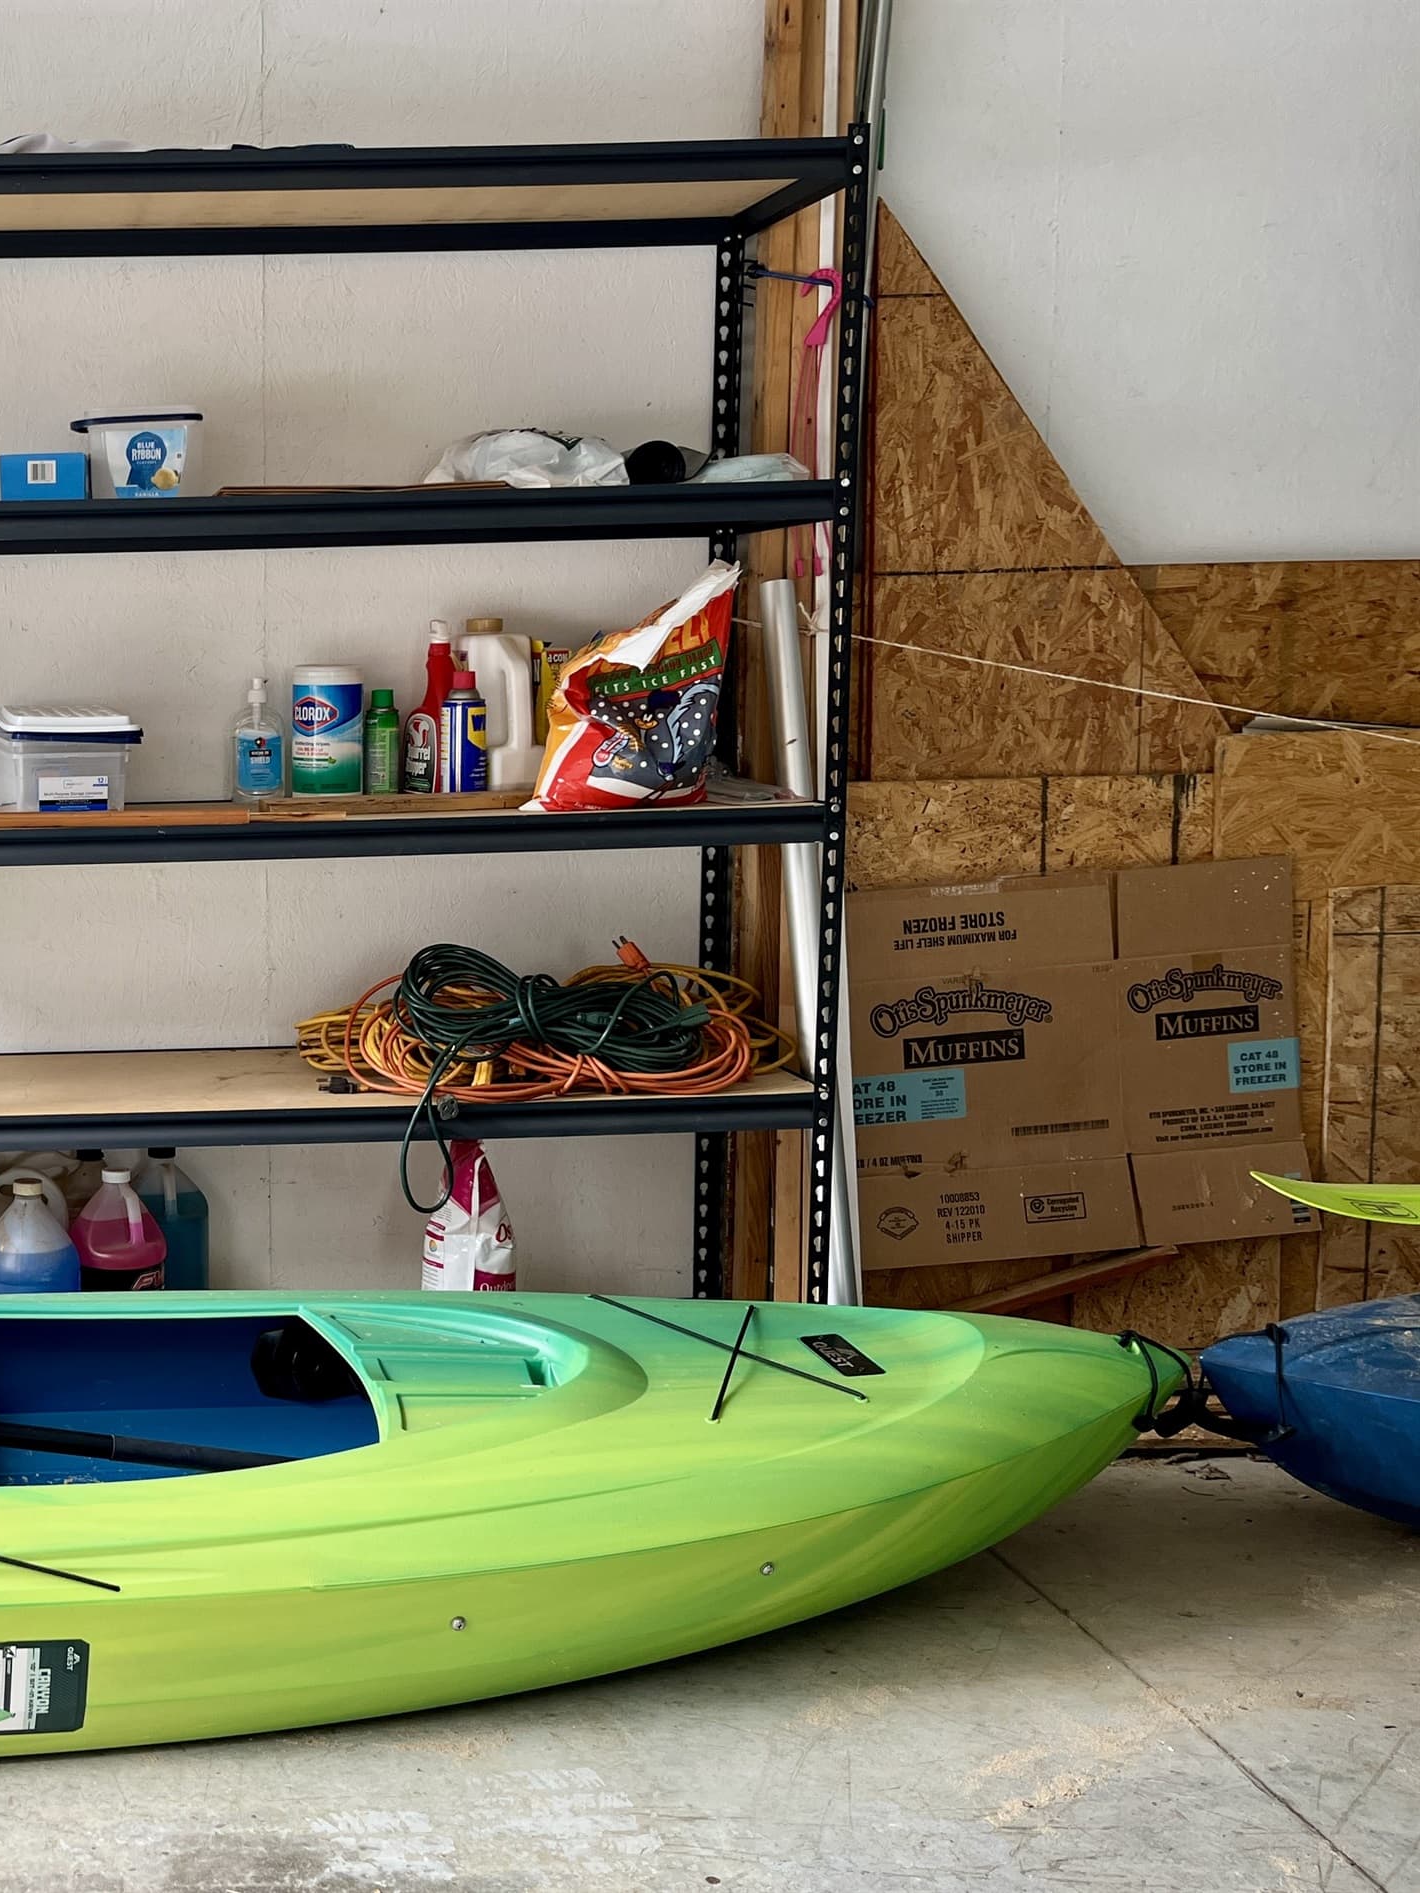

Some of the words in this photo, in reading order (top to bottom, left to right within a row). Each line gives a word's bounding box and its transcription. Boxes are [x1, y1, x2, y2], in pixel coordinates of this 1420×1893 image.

[137, 441, 155, 449] BLUE
[132, 447, 161, 461] RIBBON
[594, 681, 630, 694] ELTS
[642, 675, 669, 689] ICE
[680, 655, 716, 678] FAST
[294, 706, 331, 721] CLOROX
[902, 915, 956, 935] FROZEN
[960, 911, 1005, 930] STORE
[916, 935, 945, 948] SHELF
[947, 931, 996, 946] MAXIMUM
[998, 929, 1017, 942] FOR
[893, 939, 914, 951] LIFE
[1127, 979, 1169, 1013] Otis
[1166, 964, 1283, 1002] Spunkmeyer
[870, 999, 920, 1038] Otis
[915, 982, 1052, 1026] Spunkmeyer
[1160, 1012, 1255, 1037] MUFFINS
[908, 1037, 1020, 1066] MUFFINS
[1240, 1051, 1261, 1061] CAT
[1265, 1050, 1279, 1059] 48
[1233, 1062, 1271, 1074] STORE
[1274, 1061, 1287, 1070] IN
[1235, 1073, 1287, 1086] FREEZER
[853, 1083, 871, 1095] AT
[876, 1081, 896, 1093] 48
[853, 1097, 885, 1110] ORE
[890, 1095, 907, 1107] IN
[855, 1111, 907, 1126] EEZER
[937, 1207, 953, 1218] REV
[955, 1204, 985, 1217] 122010
[945, 1218, 966, 1231] 4-15
[969, 1217, 981, 1229] PK
[946, 1231, 983, 1244] SHIPPER
[812, 1341, 855, 1368] QUEST
[66, 1646, 74, 1671] QUEST
[36, 1668, 51, 1714] CANYON
